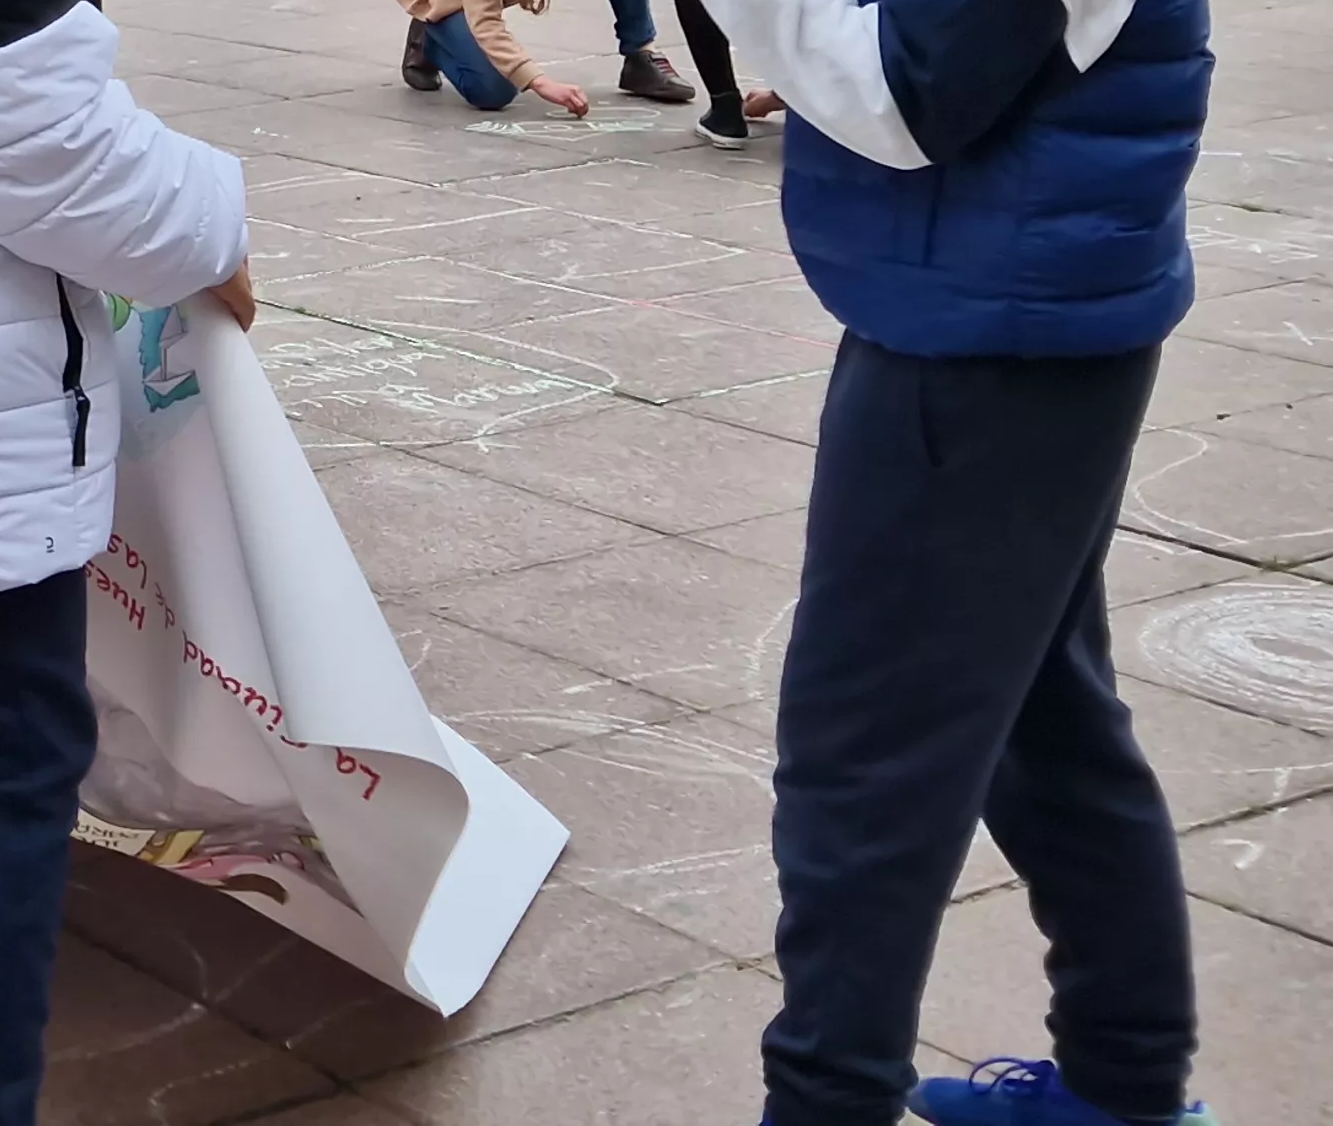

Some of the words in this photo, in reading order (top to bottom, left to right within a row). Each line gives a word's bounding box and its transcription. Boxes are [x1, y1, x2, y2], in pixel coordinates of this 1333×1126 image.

[106, 533, 149, 590] las
[85, 560, 146, 632] Hues
[335, 746, 382, 801] La
